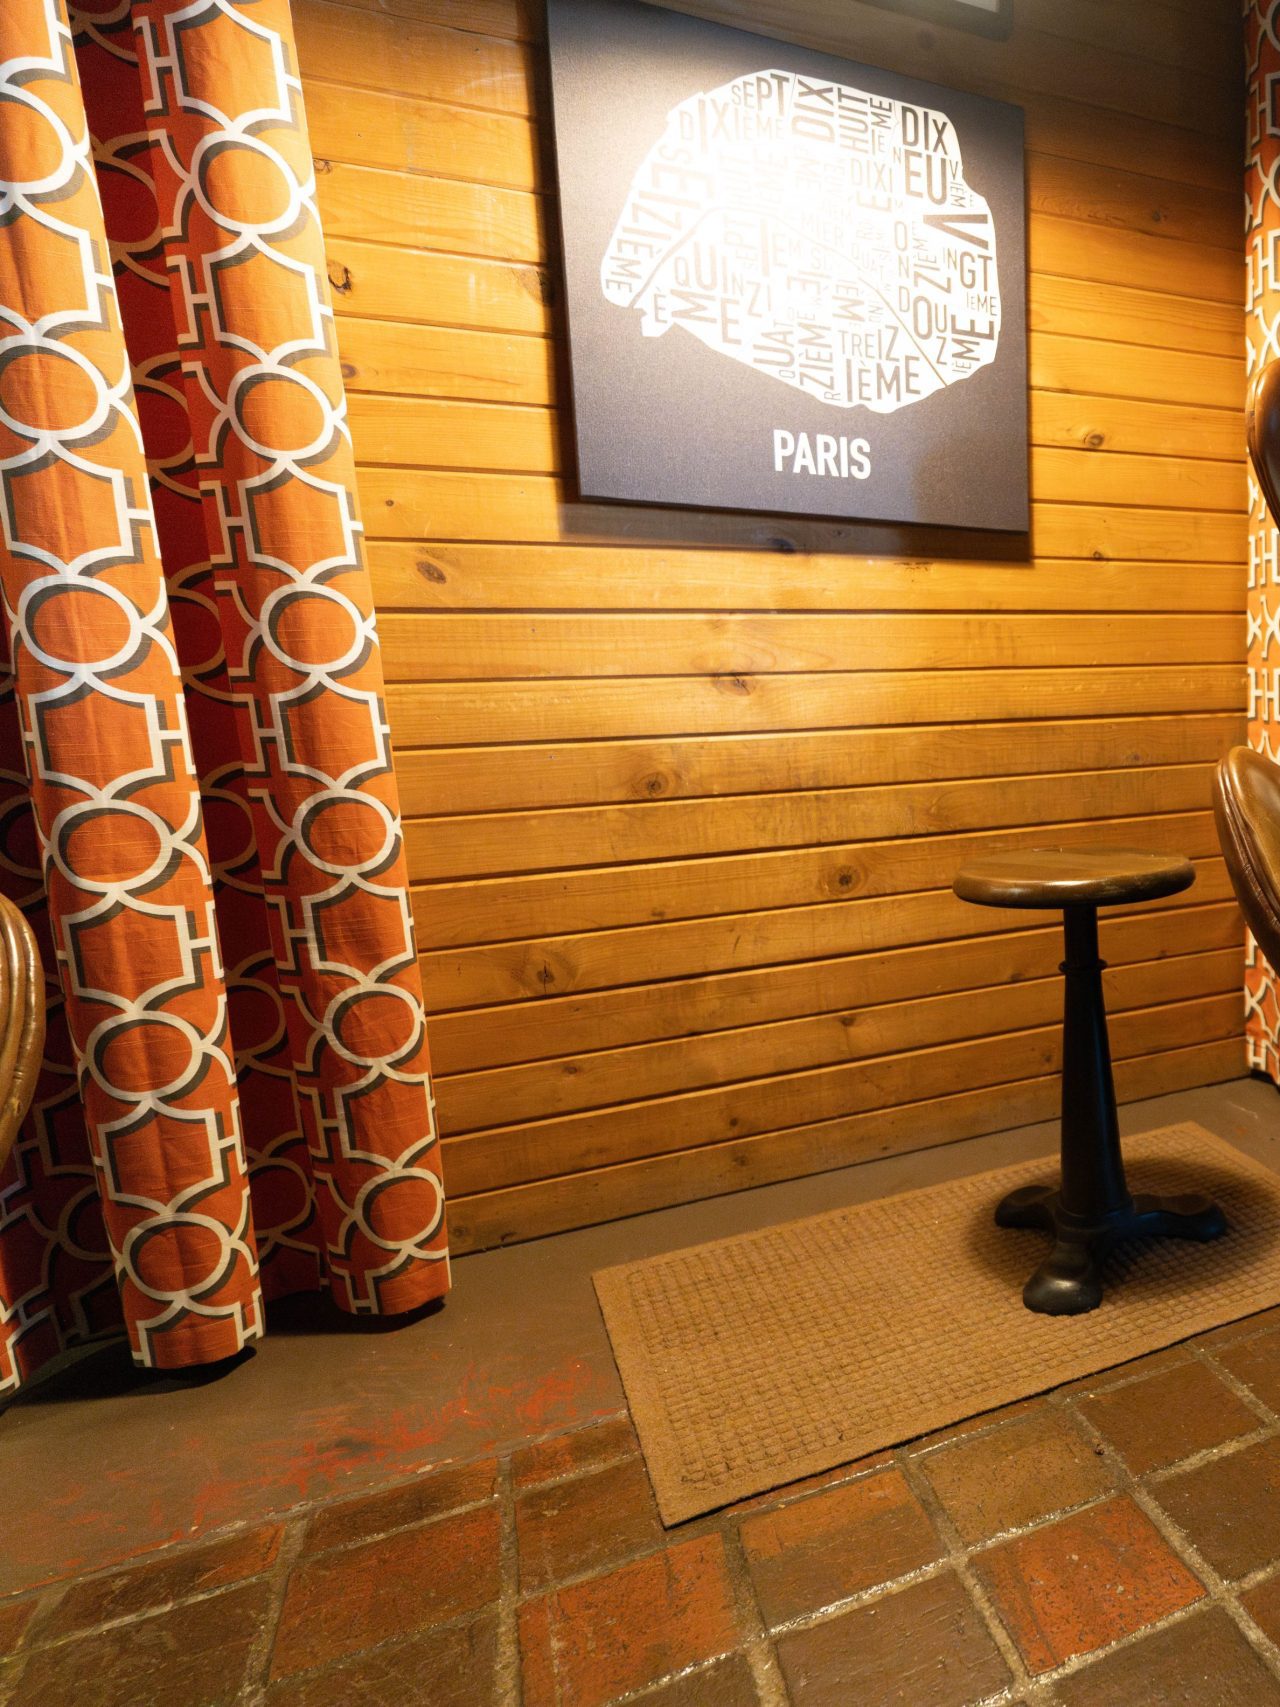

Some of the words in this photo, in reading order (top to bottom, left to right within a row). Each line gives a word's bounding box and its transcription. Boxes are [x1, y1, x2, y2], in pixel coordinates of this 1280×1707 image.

[731, 72, 790, 117] SEPT
[791, 77, 836, 144] DIX
[837, 86, 870, 154] HUIT
[901, 105, 948, 156] DIX
[772, 429, 872, 480] PARIS
